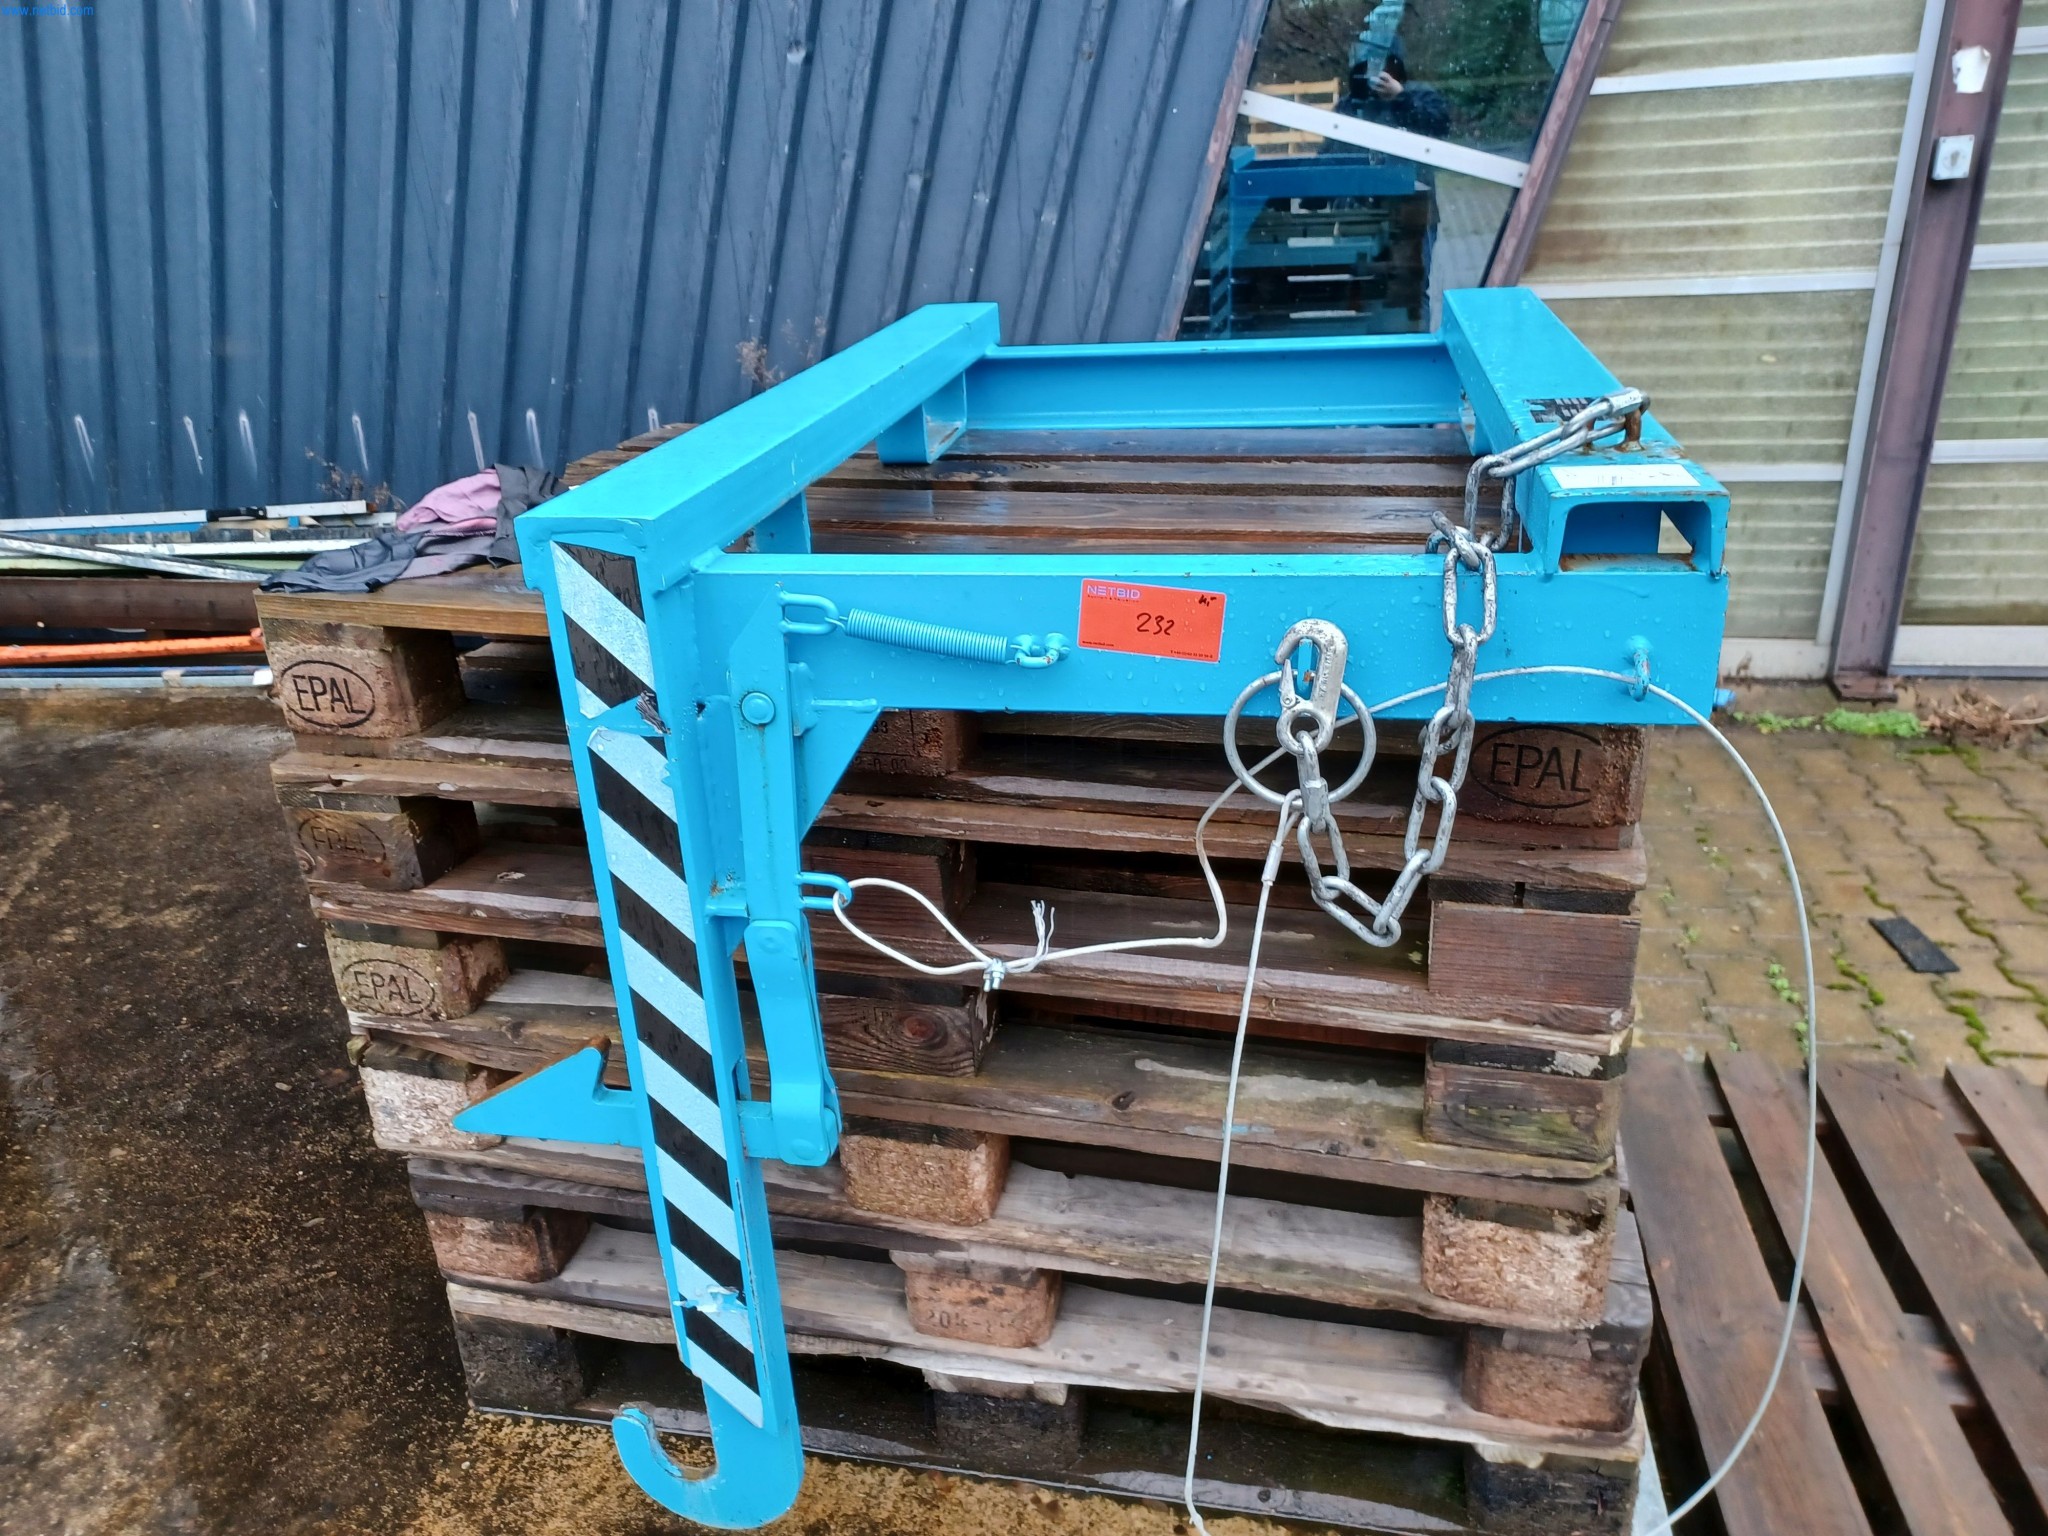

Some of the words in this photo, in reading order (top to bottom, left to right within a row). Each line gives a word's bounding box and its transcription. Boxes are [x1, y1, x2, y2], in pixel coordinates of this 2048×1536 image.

[1087, 585, 1141, 598] NETBID
[1137, 613, 1174, 635] 232
[293, 675, 366, 713] EPAL
[1490, 743, 1590, 792] EPAL
[354, 971, 422, 1004] EPAL
